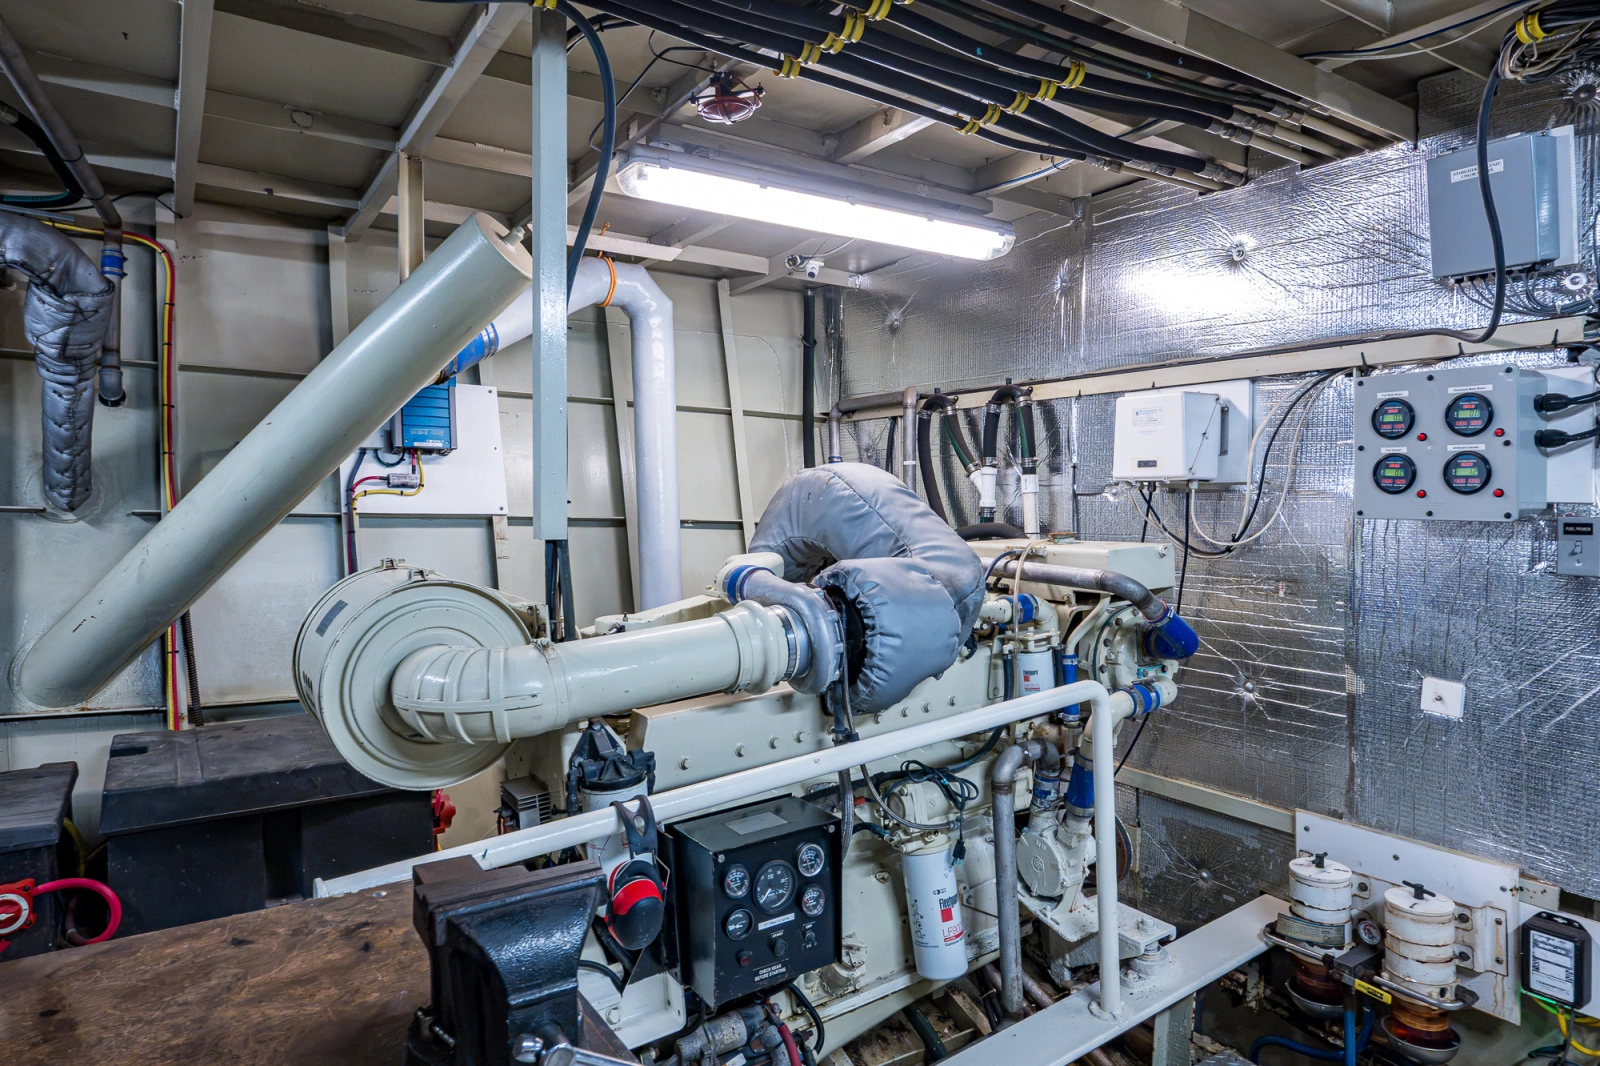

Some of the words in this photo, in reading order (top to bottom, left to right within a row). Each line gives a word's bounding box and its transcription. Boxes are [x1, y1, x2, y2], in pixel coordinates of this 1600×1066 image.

[754, 972, 768, 982] BEFORE
[768, 966, 786, 976] STARTING
[759, 966, 771, 974] CHECK
[771, 963, 782, 972] GEAR
